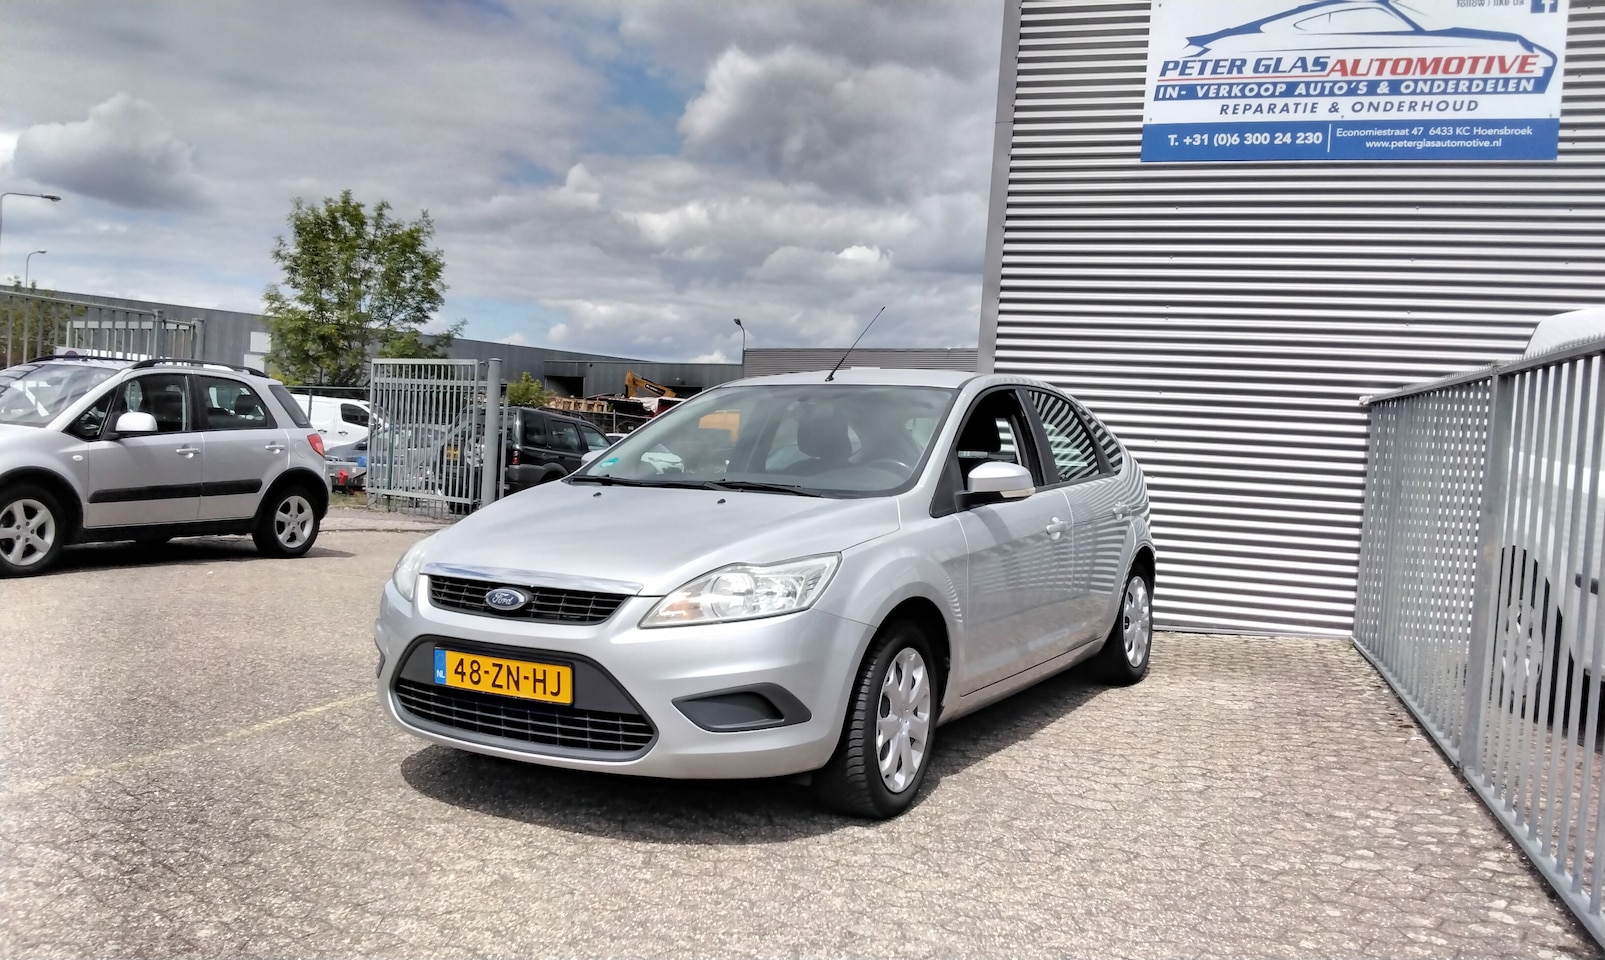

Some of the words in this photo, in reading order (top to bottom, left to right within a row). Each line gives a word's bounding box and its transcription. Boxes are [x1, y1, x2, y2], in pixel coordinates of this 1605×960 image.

[1158, 57, 1247, 78] PETER
[1158, 85, 1187, 99] IN-
[1196, 82, 1287, 98] VERKOOP
[1294, 79, 1368, 96] AUTO'S
[1376, 79, 1391, 94] &
[1400, 77, 1536, 94] ONDERDELEN
[1219, 101, 1319, 115] REPARATIE
[1328, 101, 1340, 114] &
[1351, 99, 1479, 113] ONDERHOUD
[1167, 133, 1179, 146] T.
[1183, 133, 1209, 146] +31
[1213, 132, 1240, 147] (0)6
[1243, 132, 1271, 145] 300
[1274, 132, 1292, 145] 24
[1295, 131, 1323, 144] 230
[1336, 126, 1409, 137] Economiestraat
[1411, 126, 1424, 136] 47
[1428, 126, 1453, 136] 6433
[1455, 126, 1470, 136] KC
[1473, 125, 1533, 136] Hoensbroek
[1365, 137, 1502, 149] www.peterglasautomotive.nl
[491, 592, 514, 605] Ford
[436, 669, 446, 679] NL
[454, 657, 561, 697] 48-ZN-HJ
